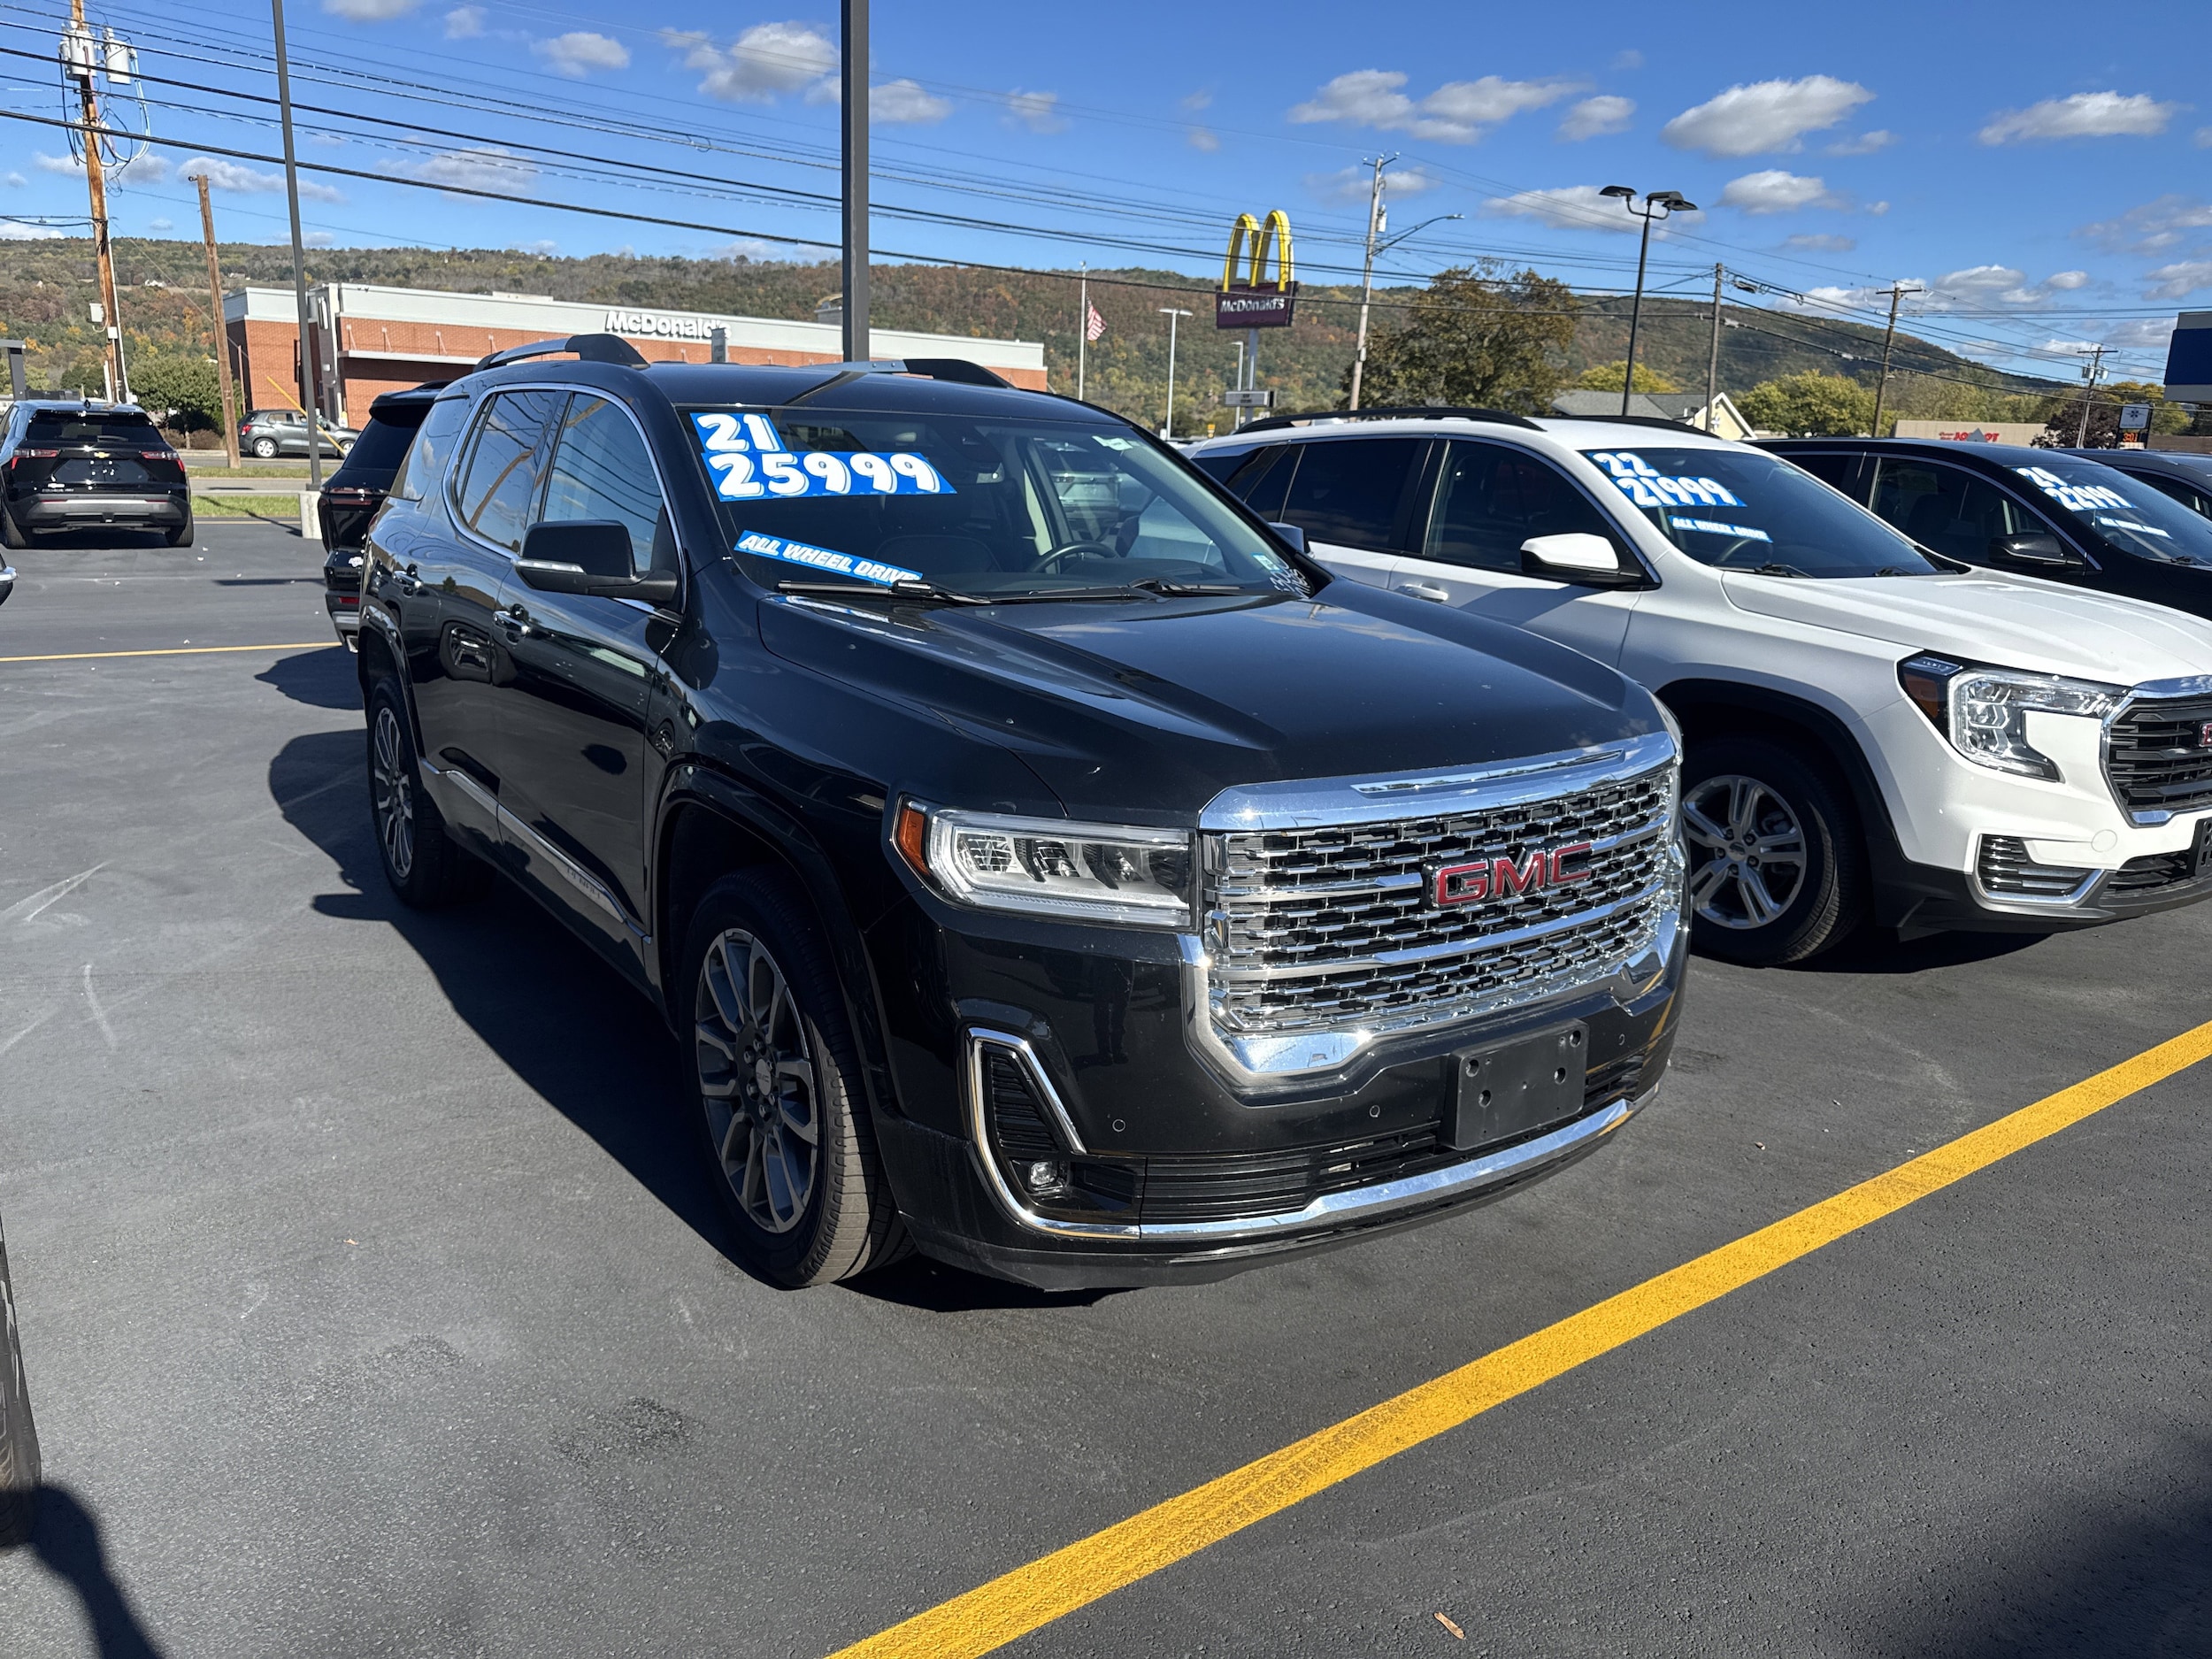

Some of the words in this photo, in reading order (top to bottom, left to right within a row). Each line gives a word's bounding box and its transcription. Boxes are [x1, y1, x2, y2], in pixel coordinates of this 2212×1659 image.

[1221, 298, 1285, 312] McDonald's
[696, 413, 780, 452] 21
[709, 452, 941, 495] 25999
[1592, 452, 1661, 478] 22
[1616, 476, 1738, 506] 21999
[738, 534, 781, 557] ALL
[782, 542, 853, 573] WHEEL
[1434, 841, 1593, 907] GMC
